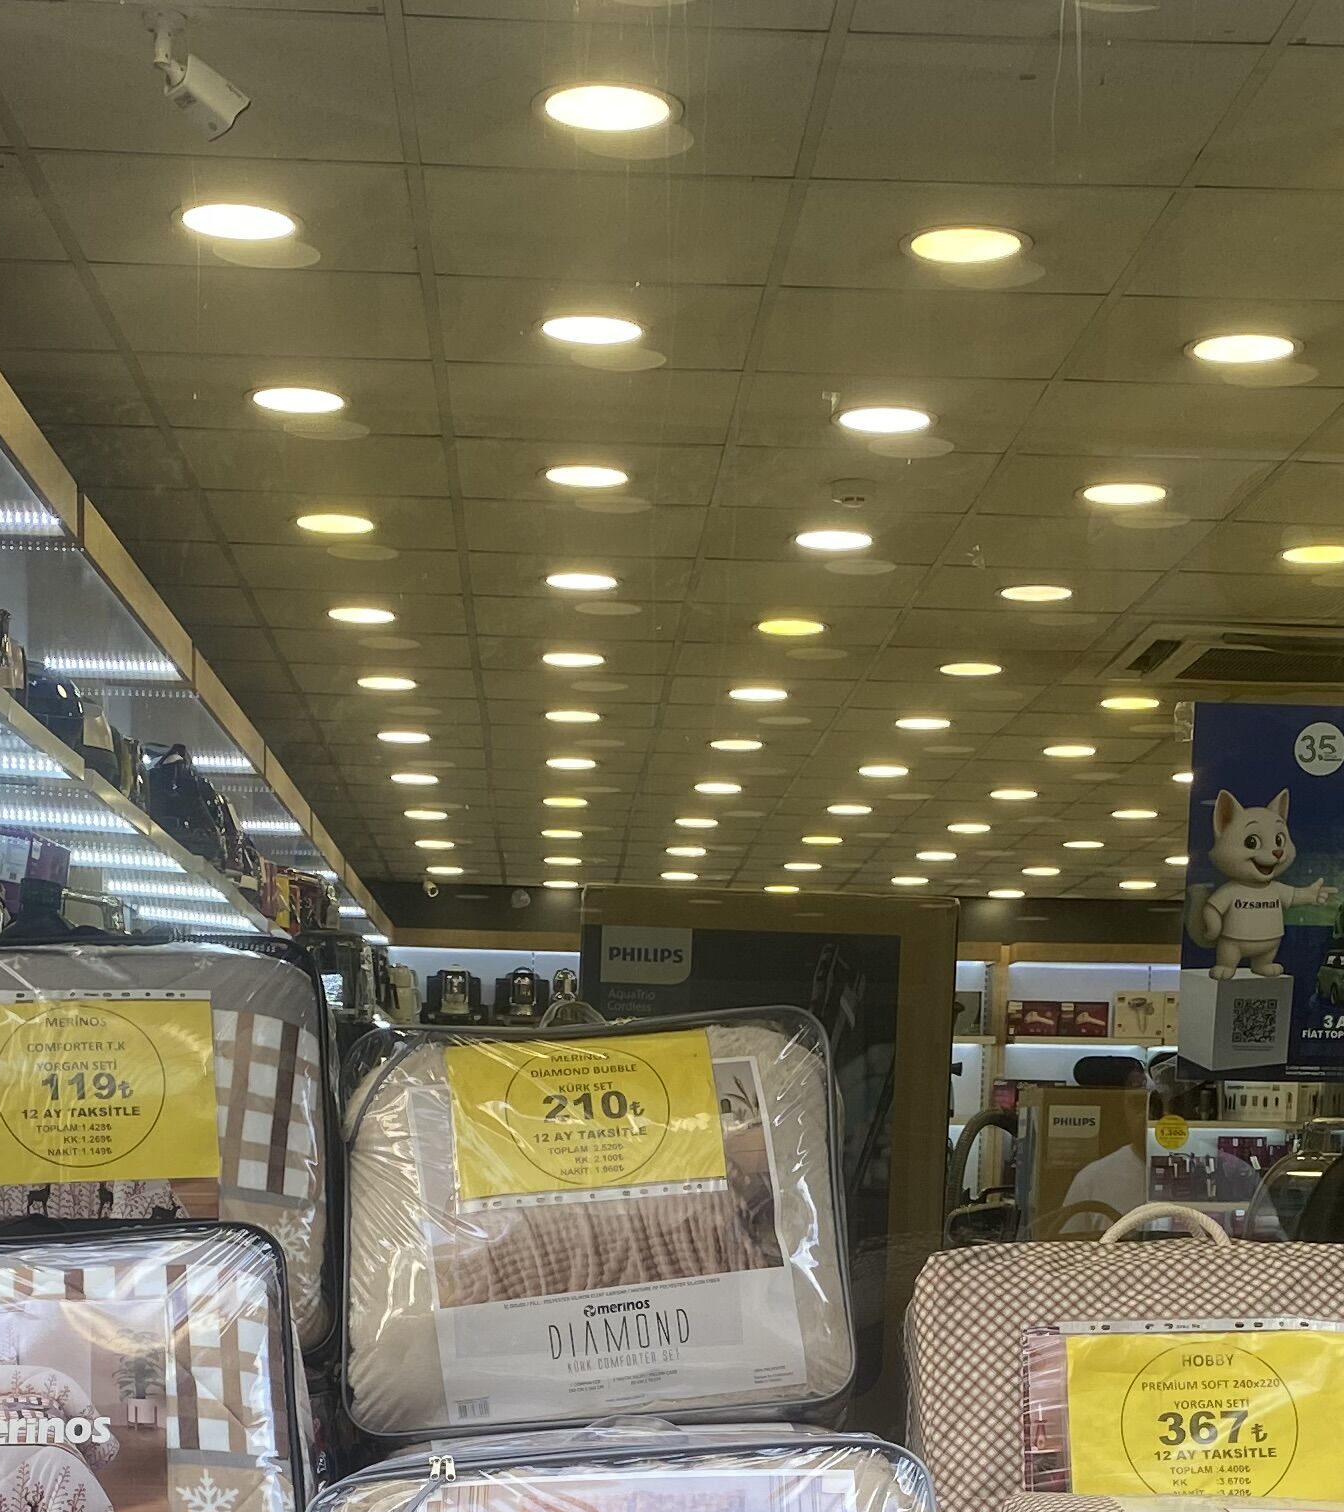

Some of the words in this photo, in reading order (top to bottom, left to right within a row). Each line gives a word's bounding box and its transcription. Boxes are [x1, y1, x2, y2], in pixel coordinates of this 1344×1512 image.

[608, 946, 684, 963] PHILIPS
[1323, 1015, 1334, 1029] 3
[27, 1041, 103, 1053] COMFORTER
[36, 1061, 89, 1072] YORGAN
[92, 1058, 117, 1071] SETİ
[530, 1066, 590, 1078] DİAMOND
[593, 1063, 637, 1074] BUBBLE
[41, 1071, 134, 1101] 119₺
[558, 1082, 591, 1094] KÜRK
[593, 1081, 614, 1091] SET
[22, 1109, 38, 1119] 12
[43, 1109, 62, 1119] AY
[70, 1104, 141, 1118] TAKSİTLE
[542, 1090, 645, 1124] 210₺
[1053, 1117, 1096, 1127] PHILIPS
[533, 1133, 550, 1143] 12
[554, 1131, 574, 1142] AY
[597, 1299, 650, 1315] merinos
[548, 1308, 690, 1360] DIAMOND
[1182, 1354, 1234, 1367] HOBBY
[1141, 1379, 1198, 1391] PREMİUM
[1200, 1380, 1229, 1390] SOFT
[1232, 1378, 1280, 1389] 240x220
[1174, 1399, 1223, 1410] YORGAN
[1226, 1397, 1250, 1409] SETİ
[1154, 1450, 1171, 1461] 12
[1176, 1450, 1197, 1461] AY
[1202, 1445, 1278, 1459] TAKSİTLE
